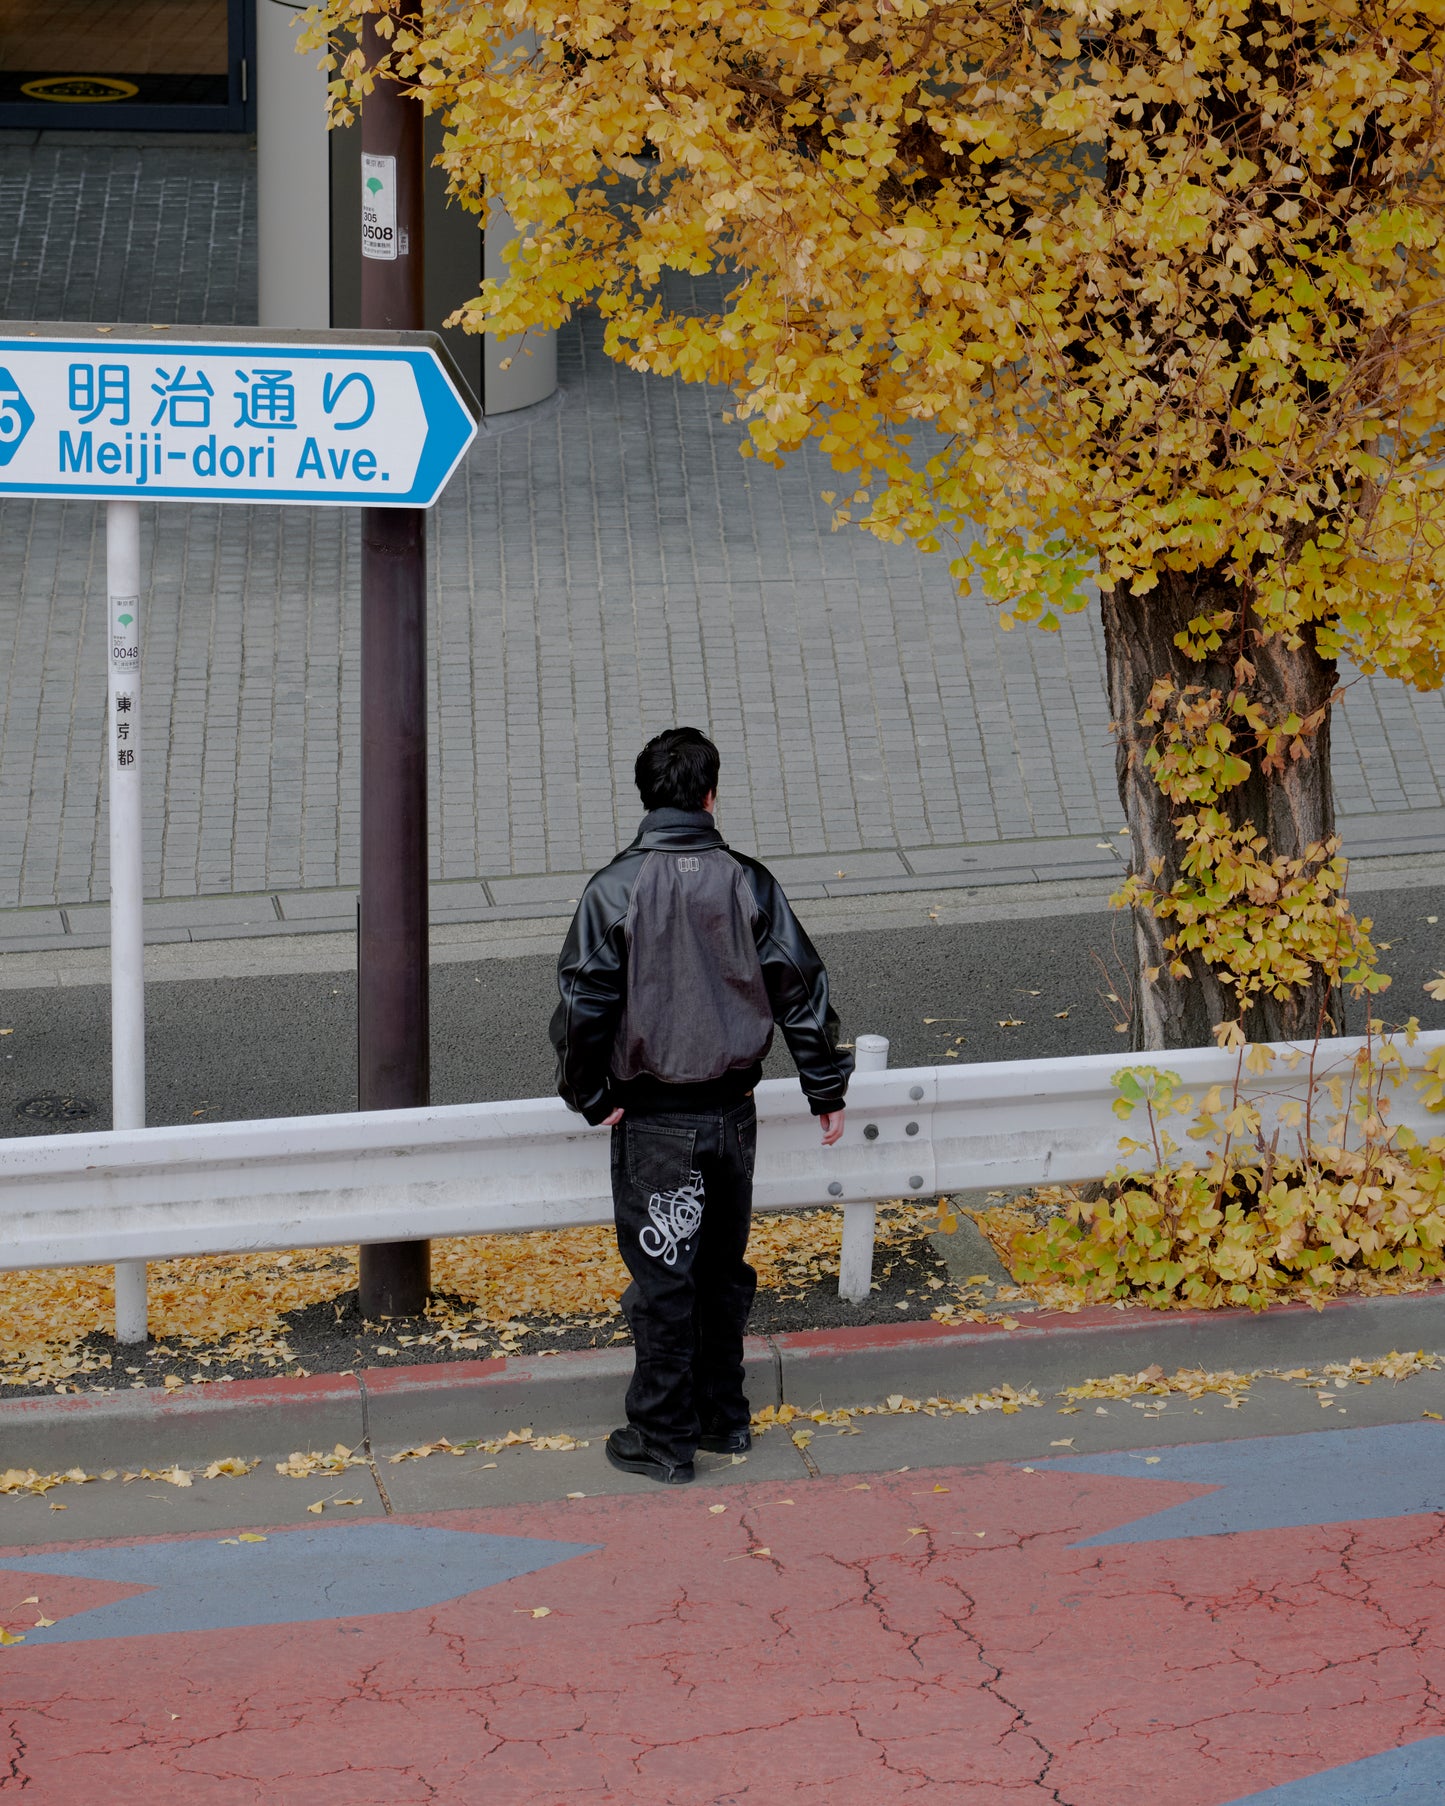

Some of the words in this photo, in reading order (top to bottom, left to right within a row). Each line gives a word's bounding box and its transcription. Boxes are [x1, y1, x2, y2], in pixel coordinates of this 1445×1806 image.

[363, 212, 377, 223] 305
[363, 224, 393, 240] 0508
[68, 363, 376, 431] 明治通り
[59, 430, 275, 485] Meiji-dori
[295, 436, 391, 482] Ave.
[113, 646, 139, 659] 0048
[116, 696, 135, 766] 東京都
